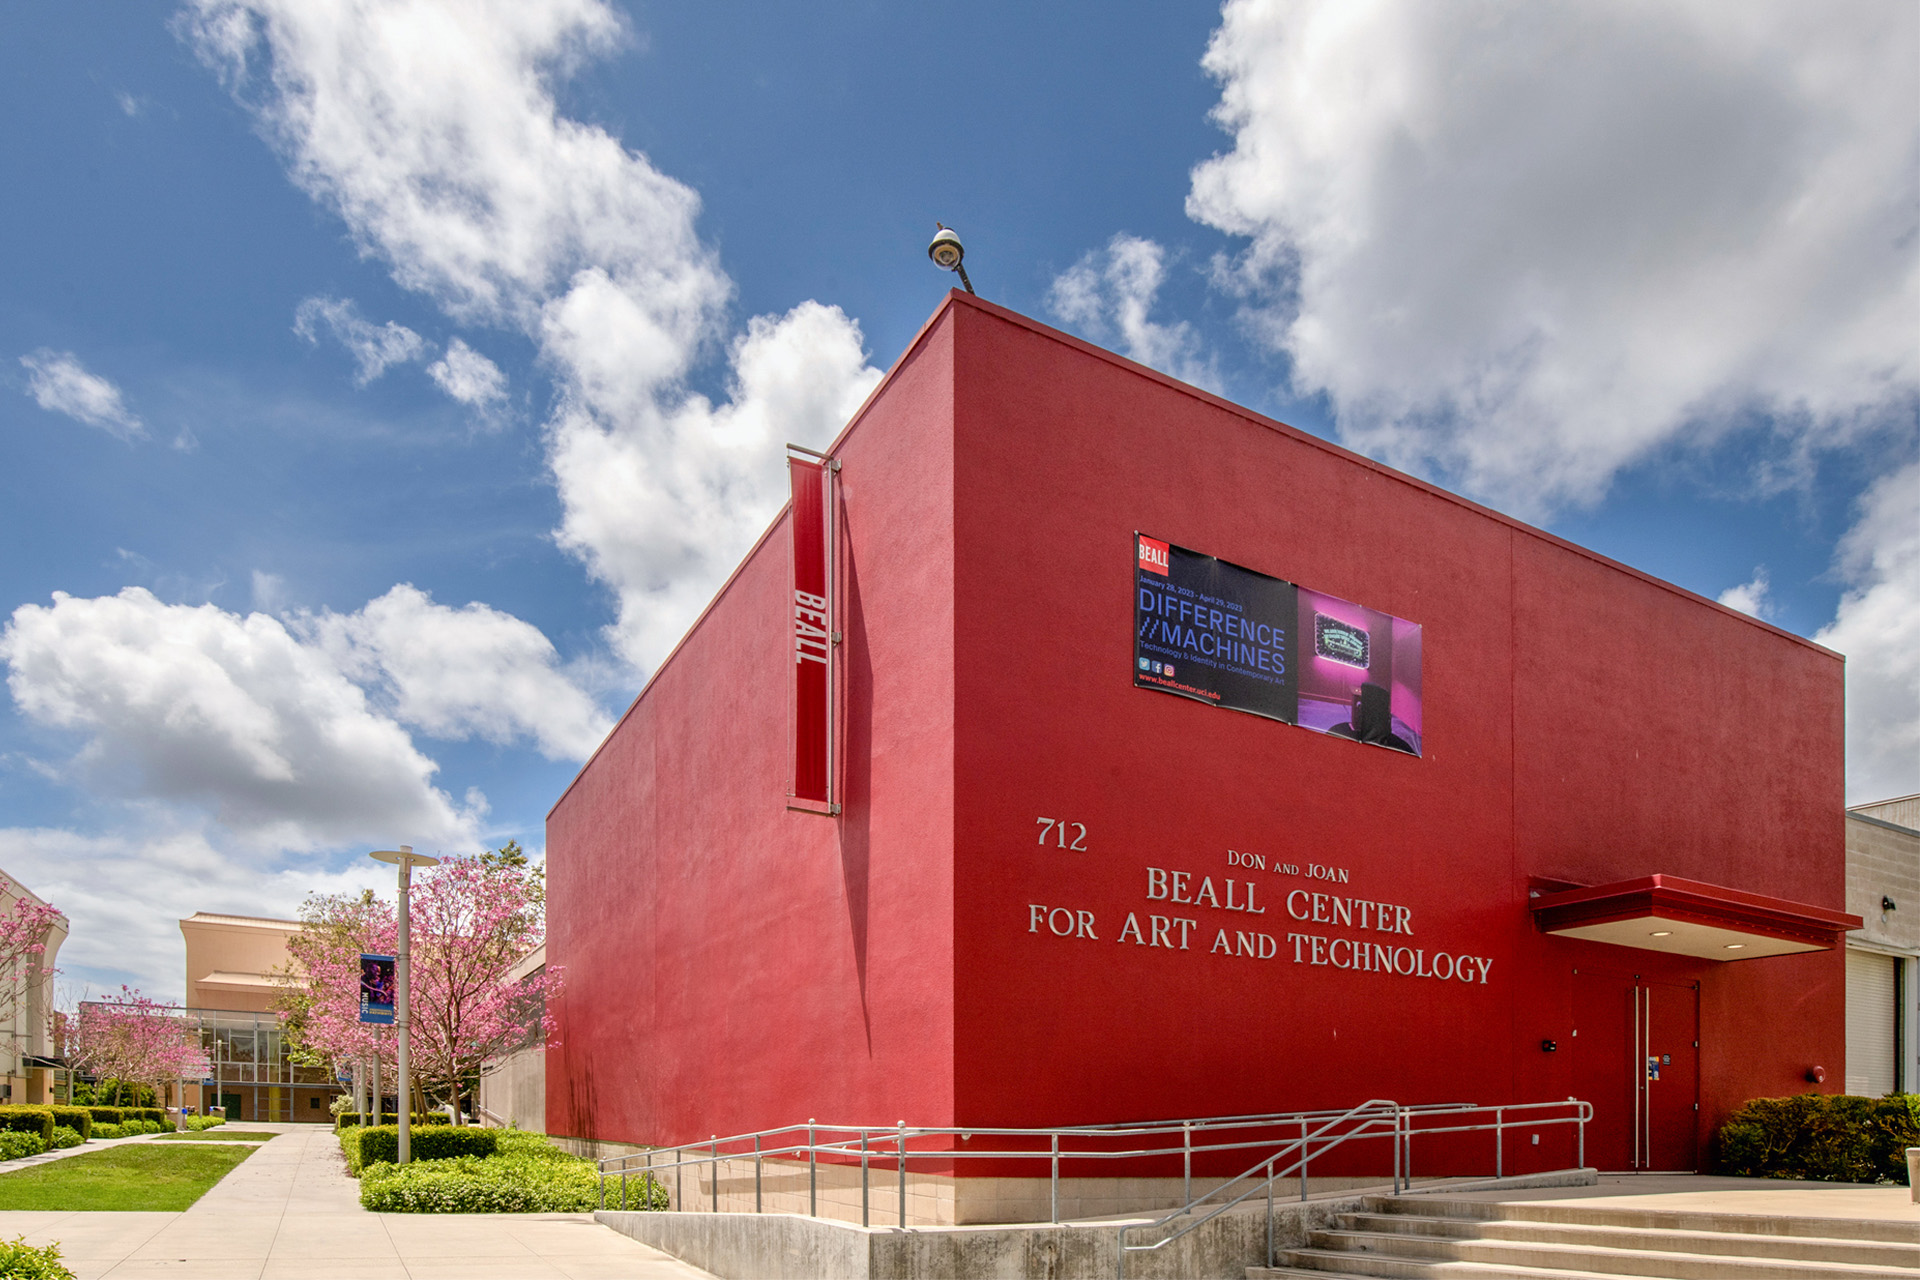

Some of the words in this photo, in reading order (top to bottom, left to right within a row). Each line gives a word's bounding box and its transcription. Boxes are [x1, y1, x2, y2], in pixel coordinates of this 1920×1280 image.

[1139, 543, 1168, 567] BEALL
[1140, 575, 1165, 590] January
[1177, 586, 1195, 598] 2023
[1199, 593, 1215, 604] April
[1226, 601, 1243, 612] 2023
[795, 589, 827, 664] BEALL
[1139, 588, 1285, 650] DIFFERENCE
[1140, 640, 1182, 659] Technology
[1190, 654, 1217, 669] Identity
[1218, 662, 1225, 670] in
[1226, 663, 1273, 684] Contemporary
[1275, 677, 1285, 686] Art
[1138, 673, 1221, 700] www.beallcenter.uci.edu
[1036, 816, 1087, 852] 712
[1227, 850, 1266, 870] DON
[1273, 862, 1299, 876] AND
[1304, 863, 1349, 884] JOAN
[1146, 867, 1266, 914] BEALL
[1286, 889, 1414, 935] CENTER
[1028, 904, 1099, 940] FOR
[1117, 912, 1197, 950] ART
[1210, 928, 1277, 959] AND
[1287, 932, 1494, 985] TECHNOLOGY
[361, 992, 369, 1014] MUSIC
